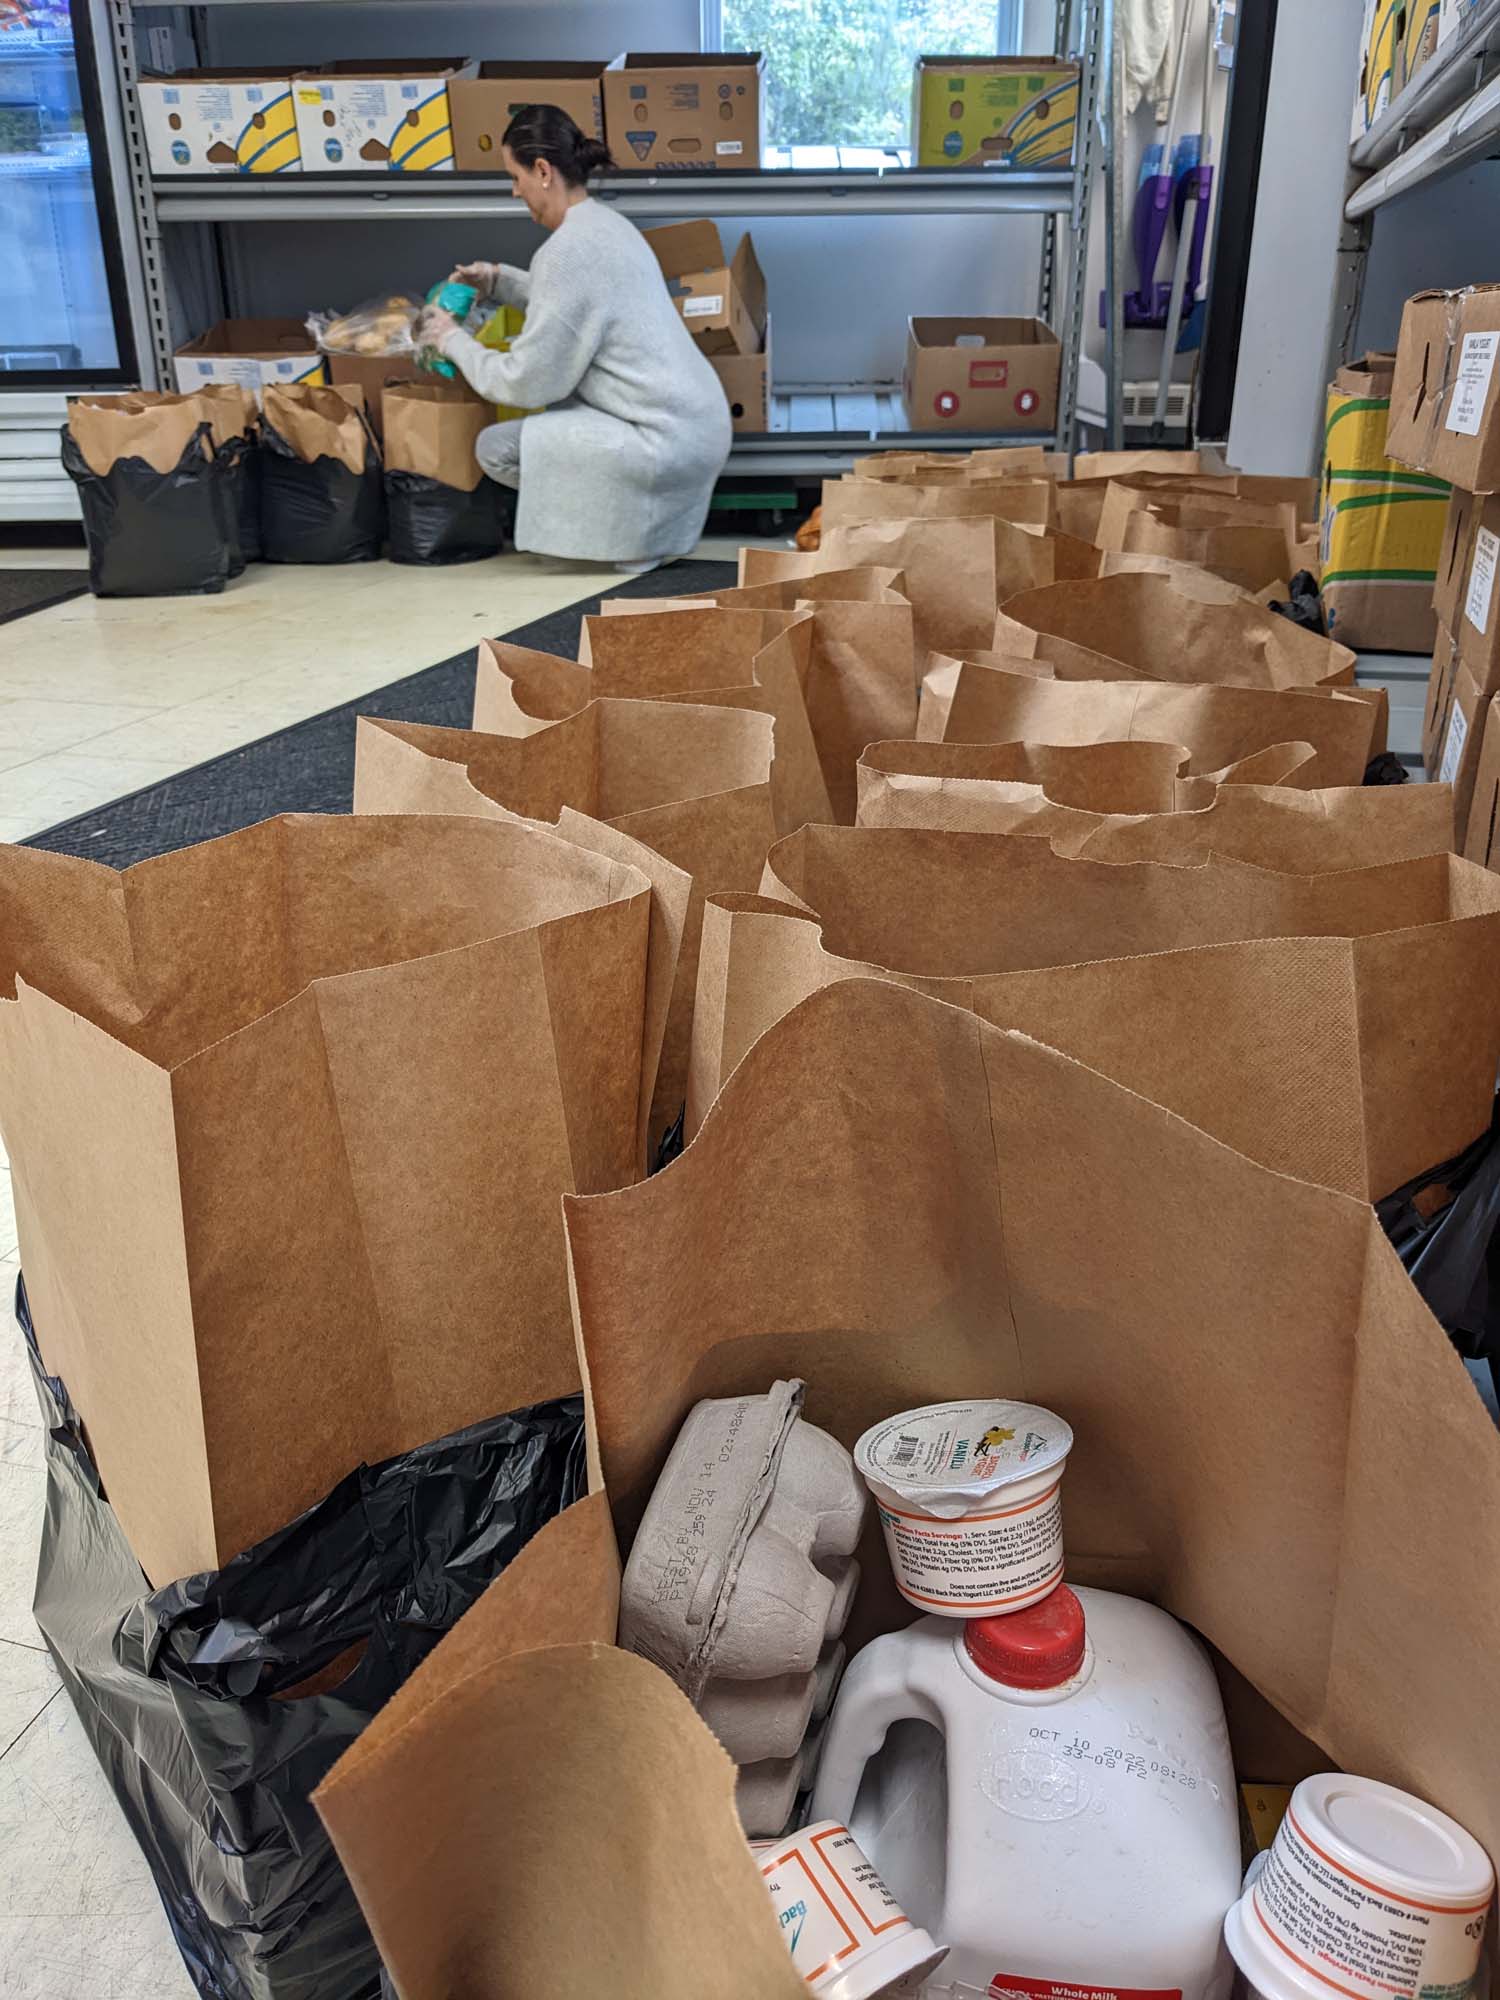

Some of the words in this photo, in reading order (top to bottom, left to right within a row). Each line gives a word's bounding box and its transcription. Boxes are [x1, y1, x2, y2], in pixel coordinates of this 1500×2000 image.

[655, 1556, 682, 1601] BEST
[676, 1527, 692, 1544] BY
[684, 1488, 704, 1514] NOV
[700, 1462, 716, 1477] 14
[914, 1530, 930, 1538] Facts
[931, 1532, 963, 1540] Servings:
[1024, 1527, 1036, 1537] (11%
[669, 1545, 699, 1600] P1928
[692, 1514, 706, 1536] 259
[701, 1490, 717, 1506] 24
[976, 1548, 993, 1556] 15mg
[1021, 1534, 1039, 1546] Sodium
[910, 1550, 919, 1560] 12g
[999, 1552, 1013, 1560] Total
[1014, 1546, 1032, 1556] Sugars
[920, 1561, 940, 1571] Protein
[996, 1557, 1026, 1569] significant
[1027, 1550, 1041, 1560] source
[1010, 1575, 1020, 1583] and
[1020, 1570, 1035, 1580] active
[963, 1590, 982, 1598] Yogurt
[1029, 1727, 1061, 1742] OCT
[1072, 1737, 1091, 1750] 10
[1103, 1746, 1146, 1767] 2022
[1150, 1761, 1197, 1790] 08:28
[1062, 1745, 1116, 1769] 33-08
[1126, 1763, 1148, 1780] F2
[1318, 1866, 1330, 1879] LLC
[1310, 1871, 1332, 1890] contain
[1330, 1873, 1350, 1892] Yogurt
[1332, 1886, 1343, 1898] not
[1351, 1888, 1366, 1902] Pack
[1309, 1896, 1320, 1909] Not
[1344, 1894, 1360, 1910] Does
[1367, 1897, 1383, 1910] Back
[1289, 1916, 1298, 1927] Sat
[1323, 1917, 1333, 1929] 0g
[1412, 1915, 1429, 1926] Plant
[1334, 1926, 1351, 1941] Fiber
[1350, 1922, 1360, 1933] 4g
[1361, 1930, 1388, 1947] Protein
[1389, 1929, 1411, 1942] potas.
[1412, 1937, 1426, 1945] and
[1326, 1943, 1335, 1954] 4g
[1407, 1947, 1422, 1957] 10%
[1336, 1951, 1348, 1962] Fat
[1362, 1952, 1374, 1963] Fat
[1386, 1950, 1400, 1961] 12g
[1317, 1951, 1353, 1976] Servings:
[1349, 1958, 1367, 1972] Total
[1375, 1959, 1419, 1977] Monounsat
[1370, 1966, 1384, 1978] 100,
[1355, 1972, 1375, 1986] Facts
[1386, 1974, 1416, 1988] Calories
[1051, 1986, 1089, 1999] Whole
[1091, 1992, 1118, 2000] Milk
[1378, 1982, 1415, 1997] Nutrition
